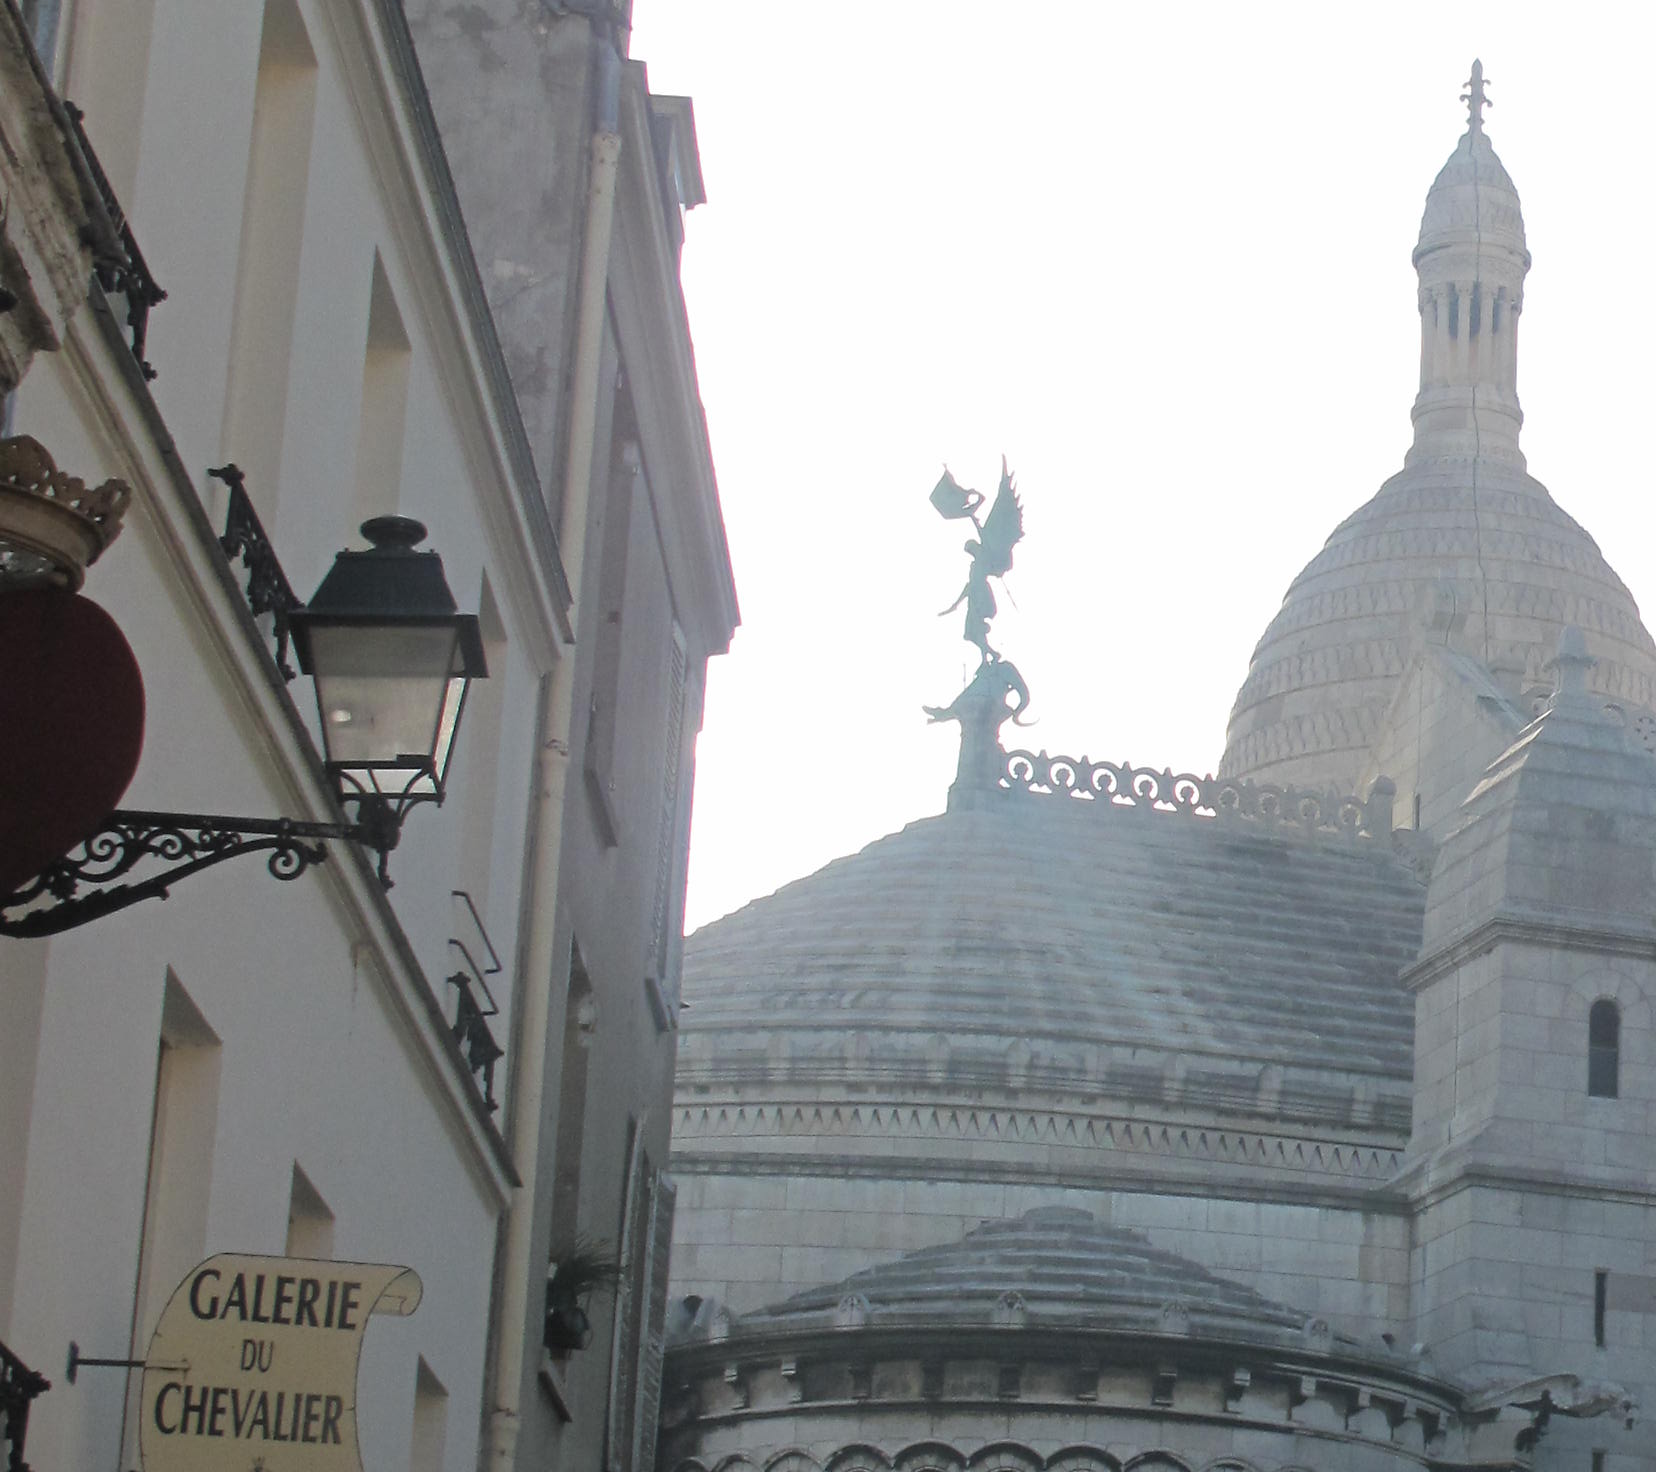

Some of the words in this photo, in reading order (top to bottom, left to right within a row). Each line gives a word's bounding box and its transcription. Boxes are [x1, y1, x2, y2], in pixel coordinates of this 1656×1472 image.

[189, 1269, 361, 1330] GALERIE
[240, 1339, 274, 1372] DU
[154, 1382, 343, 1444] CHEVALIER
